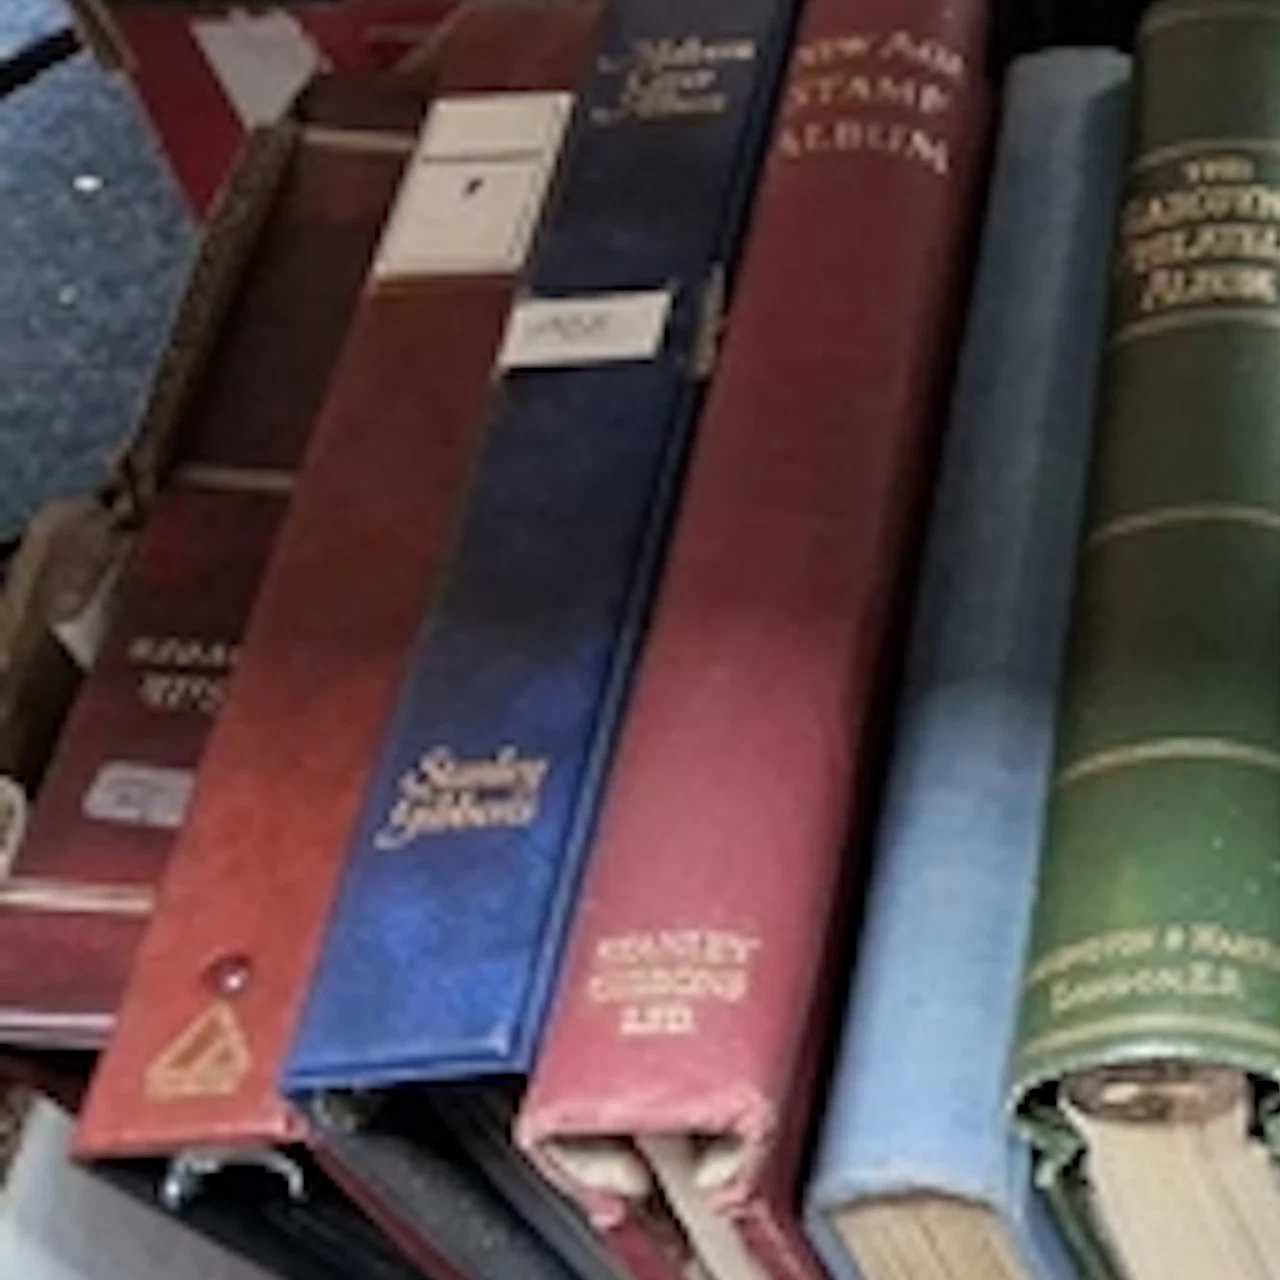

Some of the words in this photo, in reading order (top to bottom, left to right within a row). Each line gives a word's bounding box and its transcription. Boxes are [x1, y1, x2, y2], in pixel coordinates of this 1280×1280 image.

[779, 118, 950, 176] ALBUM
[403, 744, 549, 798] Stanley
[597, 928, 762, 967] STANLEY
